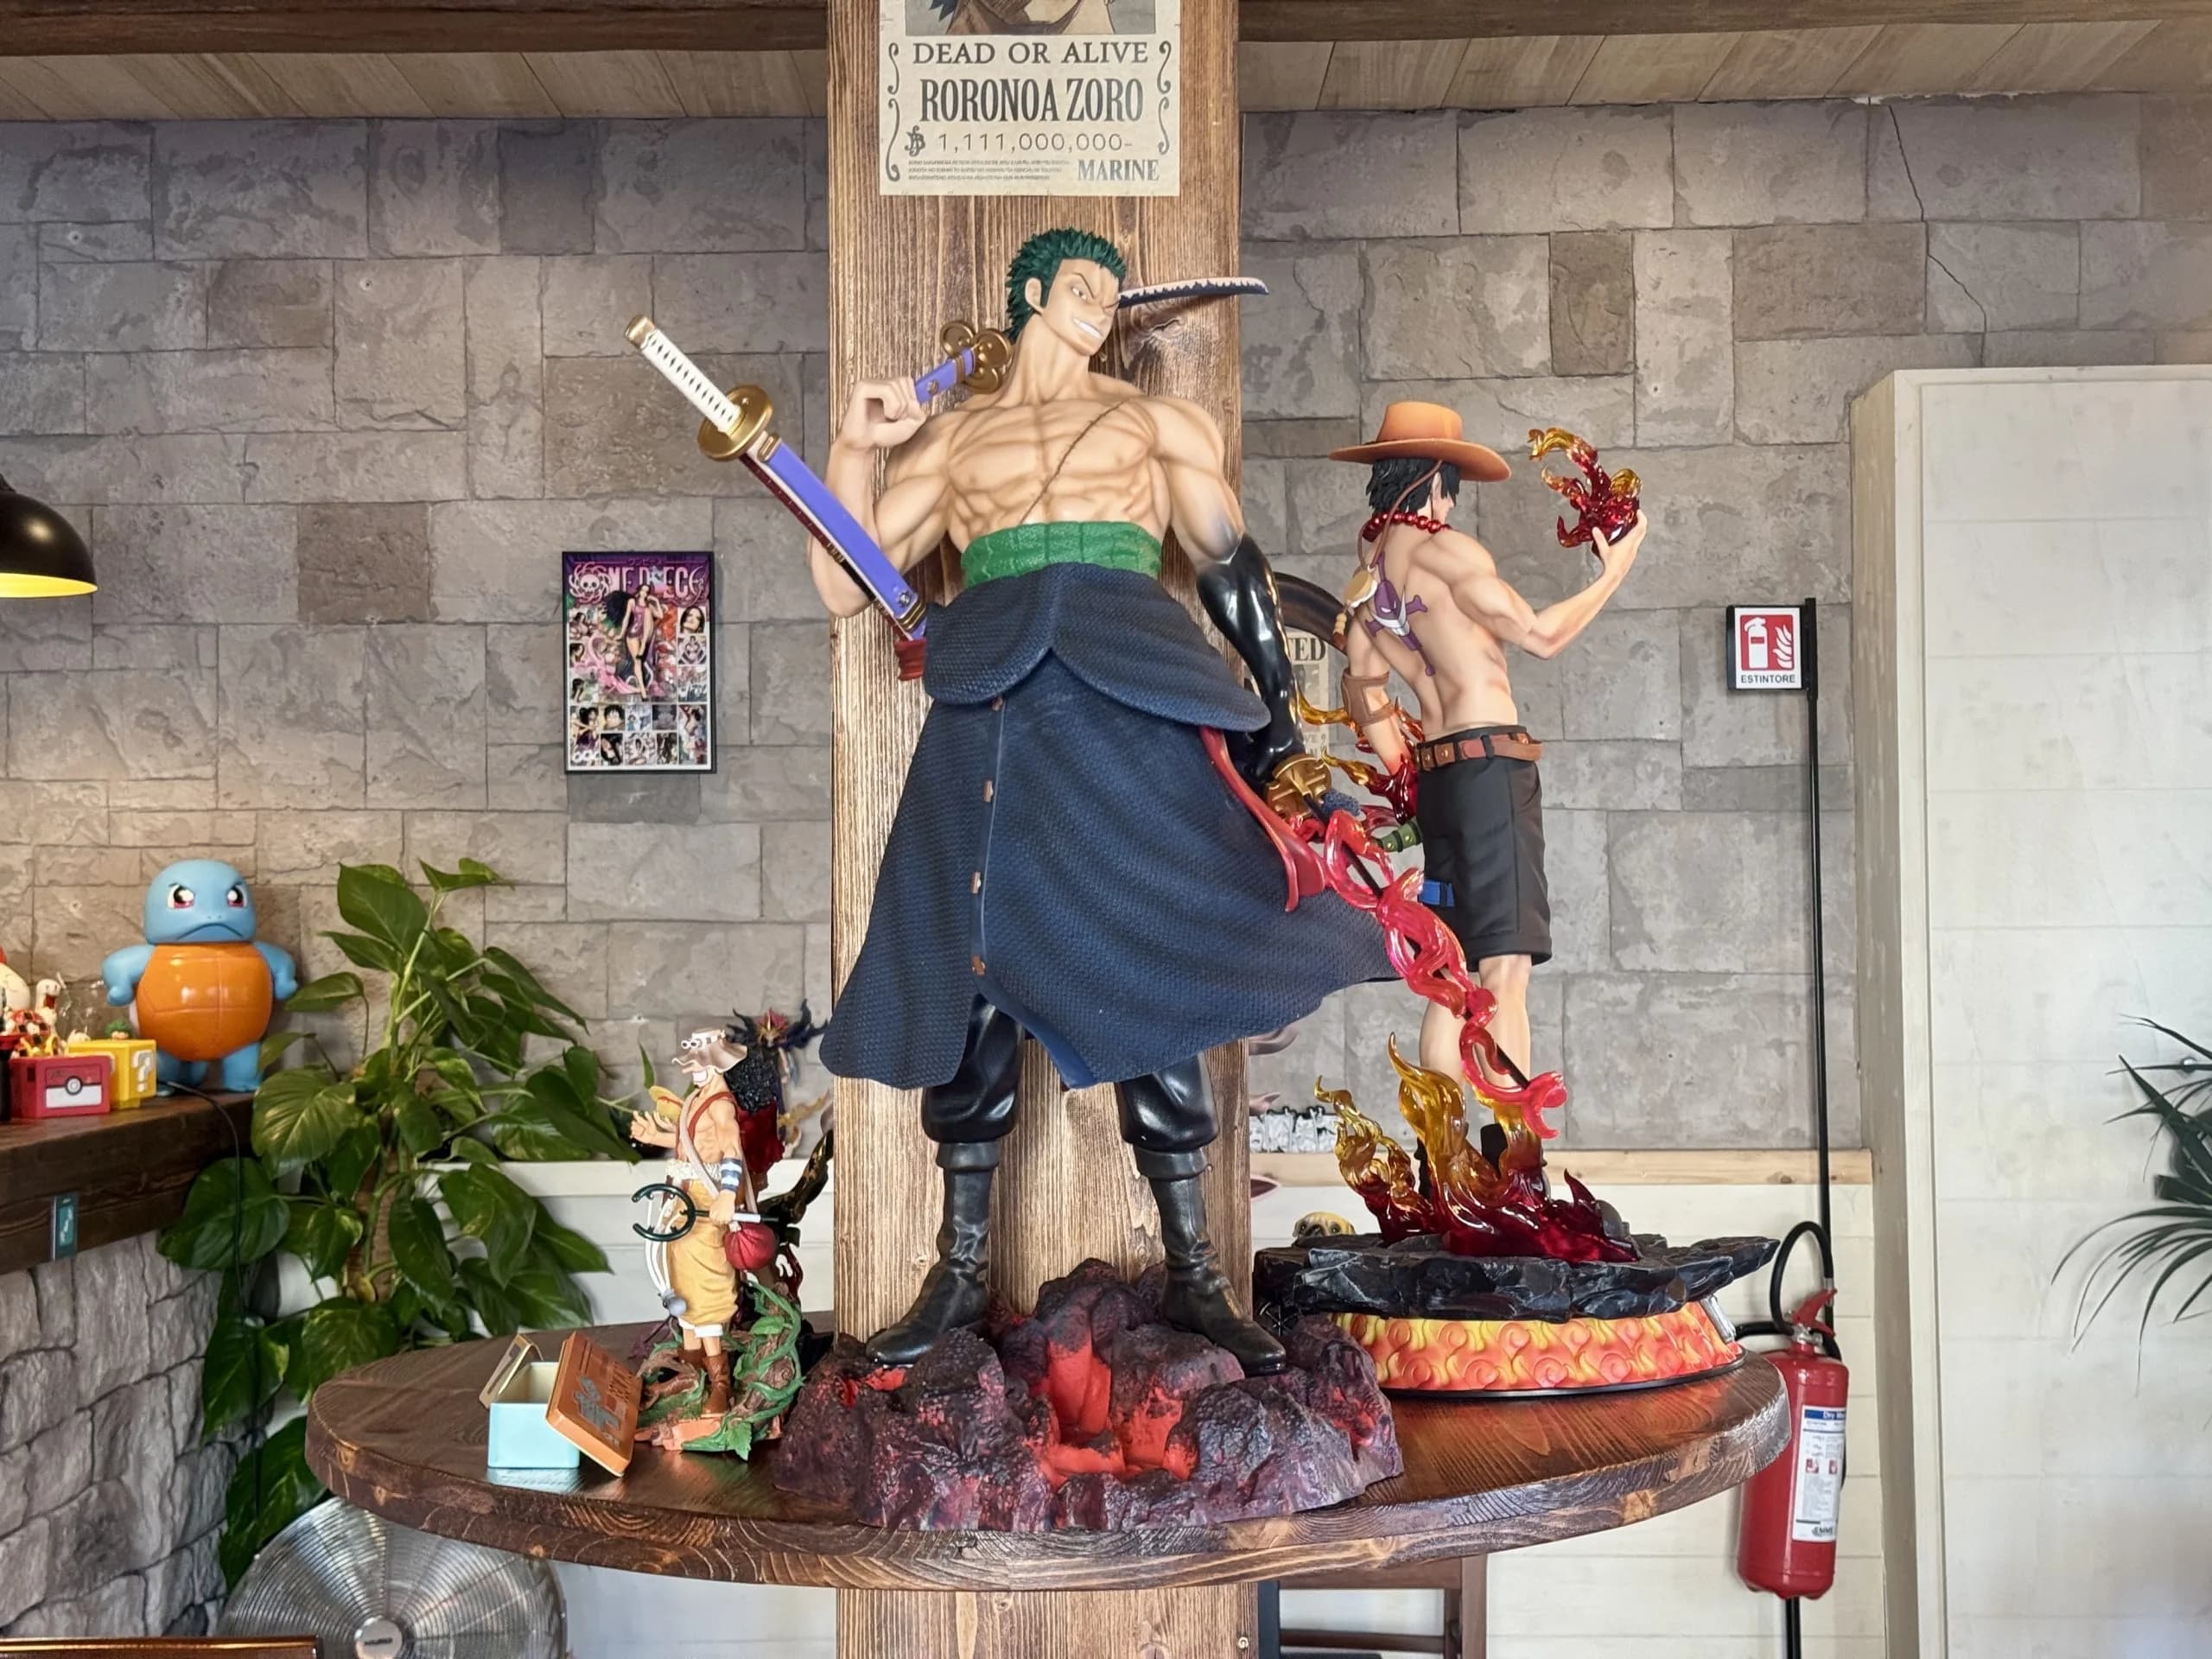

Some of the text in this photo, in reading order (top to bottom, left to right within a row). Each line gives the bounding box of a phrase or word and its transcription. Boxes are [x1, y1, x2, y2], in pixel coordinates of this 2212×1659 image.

[912, 41, 1149, 65] DEAD OR ALIVE
[918, 77, 1144, 123] RORONOA ZORO
[1077, 158, 1160, 181] MARINE
[1740, 674, 1796, 683] ESTINTORE
